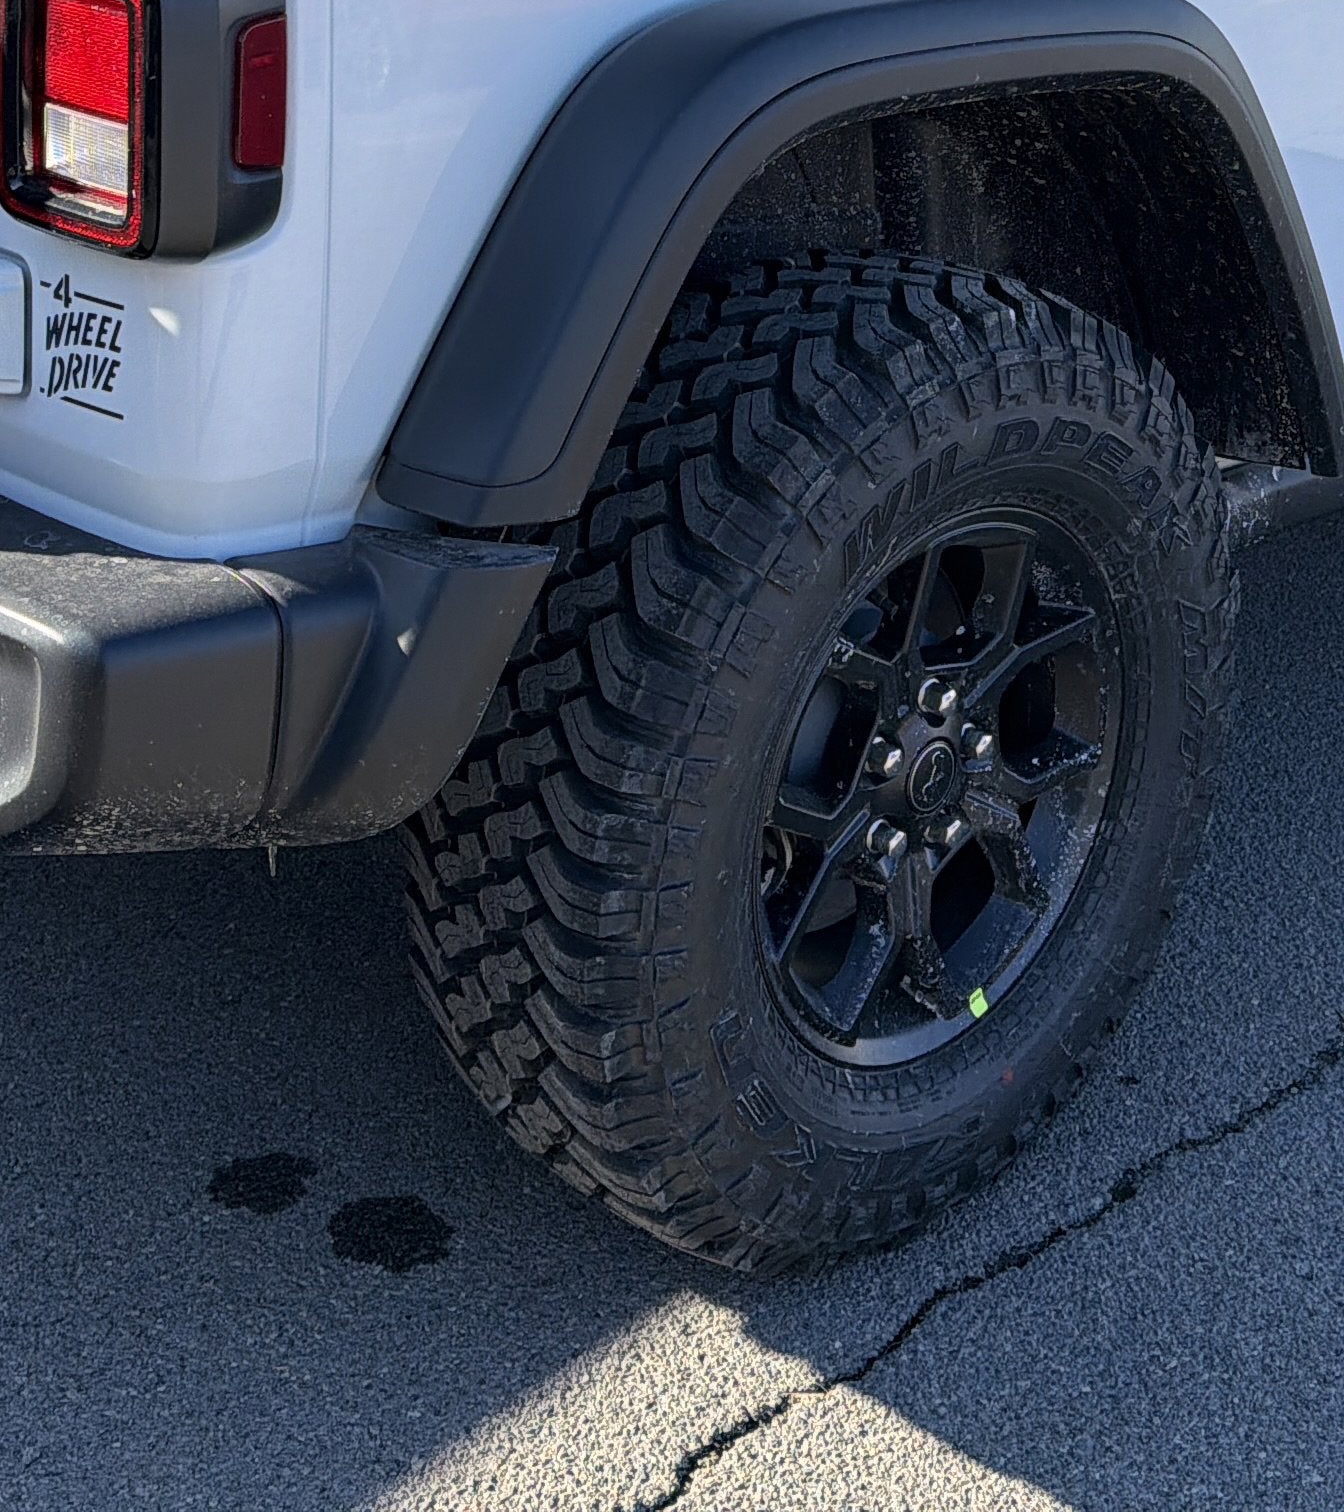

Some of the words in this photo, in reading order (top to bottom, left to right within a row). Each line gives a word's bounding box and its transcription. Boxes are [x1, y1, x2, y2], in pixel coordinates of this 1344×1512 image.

[53, 273, 72, 308] 4
[46, 311, 123, 354] WHEEL
[47, 353, 121, 398] DRIVE
[843, 414, 1194, 586] WILDPEAK
